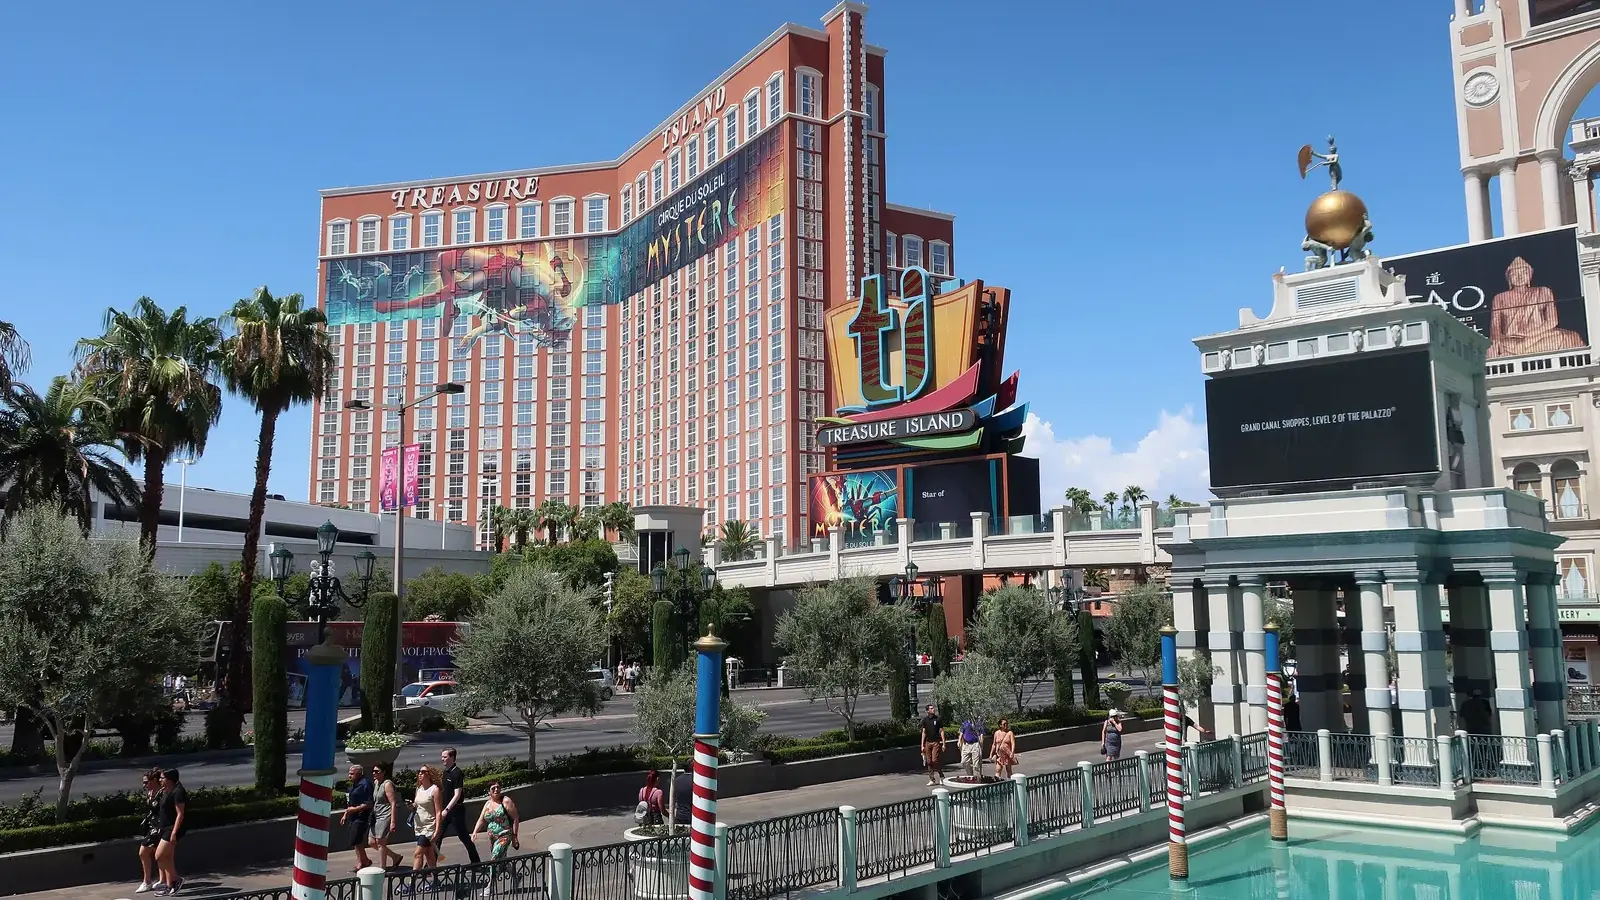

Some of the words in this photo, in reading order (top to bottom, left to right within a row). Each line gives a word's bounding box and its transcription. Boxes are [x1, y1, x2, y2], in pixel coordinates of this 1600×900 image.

[662, 85, 726, 151] ISLAND
[391, 177, 539, 208] TREASURE
[658, 199, 685, 226] CIRQUE
[685, 193, 697, 214] DU
[697, 173, 726, 201] SOLEIL
[646, 187, 738, 278] MYSTÈRE
[1426, 271, 1446, 286] 道
[826, 422, 897, 444] TREASURE
[906, 412, 963, 434] ISLAND
[1240, 423, 1261, 433] GRAND
[1261, 421, 1281, 431] CANAL
[1282, 417, 1312, 428] SHOPPES,
[1312, 415, 1331, 425] LEVEL
[1332, 413, 1337, 423] 2
[1337, 413, 1346, 422] OF
[1347, 412, 1360, 421] THE
[922, 491, 936, 499] Star
